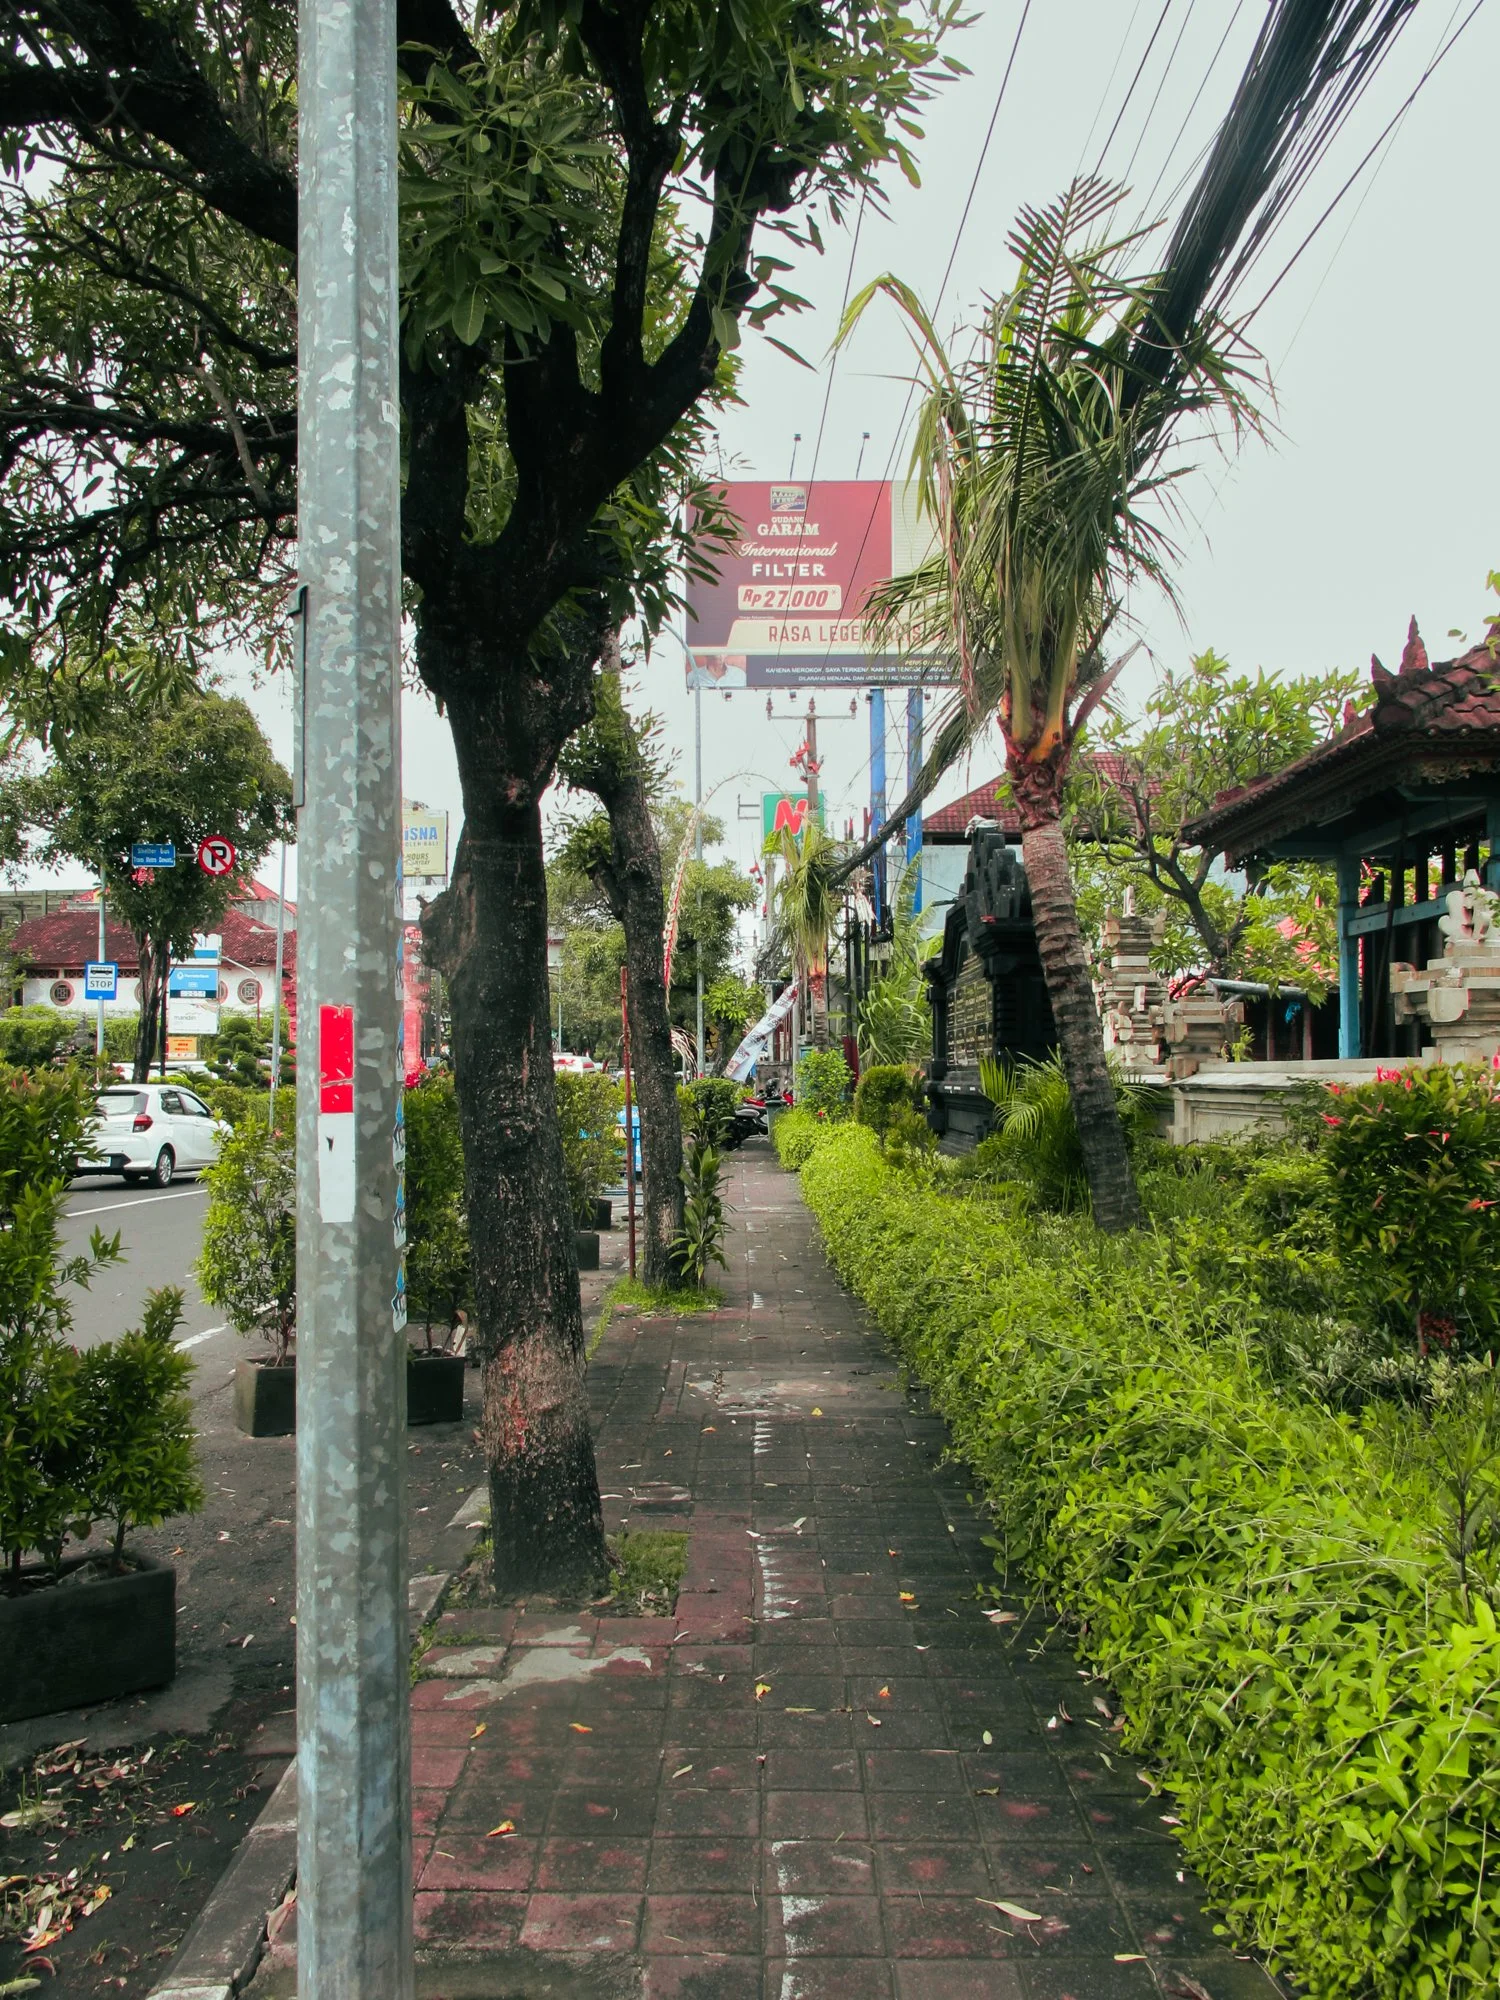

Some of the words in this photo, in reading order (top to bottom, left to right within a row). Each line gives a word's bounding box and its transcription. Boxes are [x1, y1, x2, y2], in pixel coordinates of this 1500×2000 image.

[757, 523, 819, 536] GARAM
[739, 541, 838, 557] International
[752, 563, 826, 577] FILTER
[769, 626, 811, 641] RASA
[404, 824, 438, 841] iSNA
[89, 980, 112, 988] STOP
